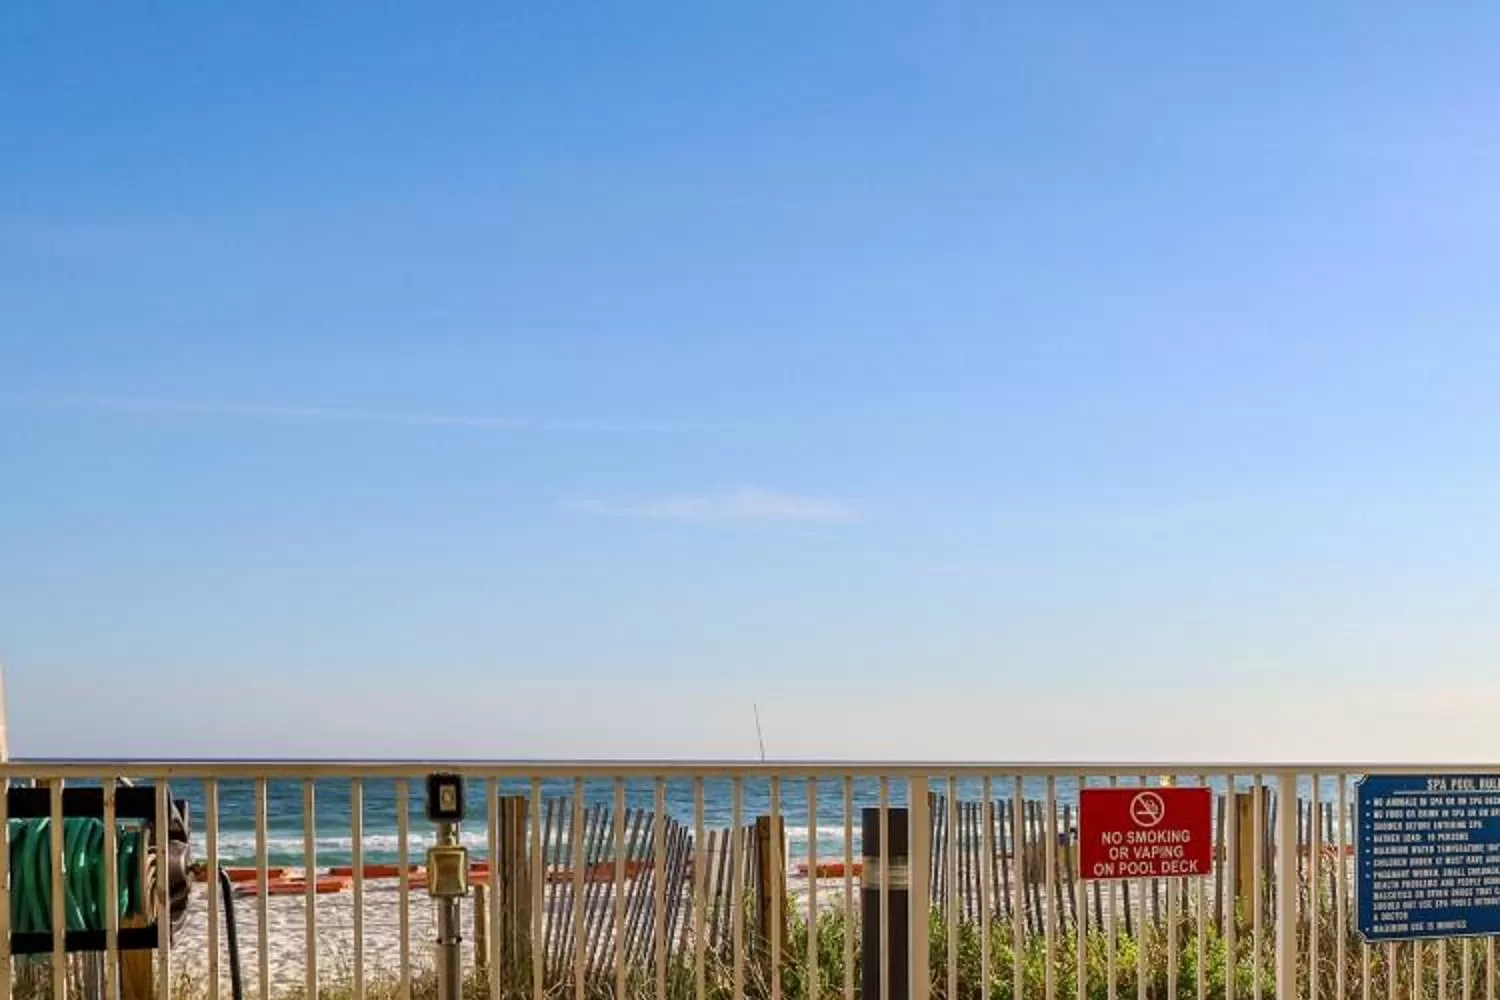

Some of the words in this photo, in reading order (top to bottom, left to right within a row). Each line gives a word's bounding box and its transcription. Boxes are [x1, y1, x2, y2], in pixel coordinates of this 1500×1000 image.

[1427, 779, 1446, 790] SPA
[1451, 778, 1475, 790] POOL
[1374, 797, 1384, 806] NO
[1420, 797, 1426, 806] IN
[1430, 796, 1443, 806] SPA
[1446, 796, 1454, 806] OR
[1458, 796, 1467, 805] ON
[1470, 796, 1482, 805] SPA
[1374, 809, 1384, 818] NO
[1386, 809, 1403, 818] FOOD
[1406, 809, 1416, 818] OR
[1418, 808, 1439, 818] DRINK
[1442, 808, 1449, 817] IN
[1452, 808, 1465, 817] SPA
[1468, 808, 1476, 816] OR
[1479, 808, 1488, 816] ON
[1374, 821, 1403, 830] SHOWER
[1406, 821, 1431, 830] BEFORE
[1434, 820, 1466, 830] ENTERING
[1469, 820, 1483, 828] SPA
[1102, 831, 1122, 845] NO
[1127, 830, 1191, 844] SMOKING
[1438, 832, 1469, 842] PERSONS
[1109, 846, 1129, 860] OR
[1133, 845, 1184, 858] VAPING
[1412, 845, 1434, 854] WATER
[1374, 858, 1407, 867] CHILDREN
[1410, 857, 1433, 866] UNDER
[1445, 856, 1465, 865] MUST
[1466, 856, 1484, 864] HAVE
[1093, 862, 1115, 876] ON
[1119, 861, 1156, 875] POOL
[1161, 860, 1199, 873] DECK
[1443, 868, 1466, 877] SMALL
[1402, 880, 1439, 889] PROBLEMS
[1441, 878, 1455, 888] AND
[1457, 877, 1481, 886] PEOPLE
[1414, 890, 1424, 898] OR
[1427, 889, 1449, 898] OTHER
[1476, 887, 1493, 896] THAT
[1435, 899, 1449, 908] SPA
[1374, 912, 1378, 920] A
